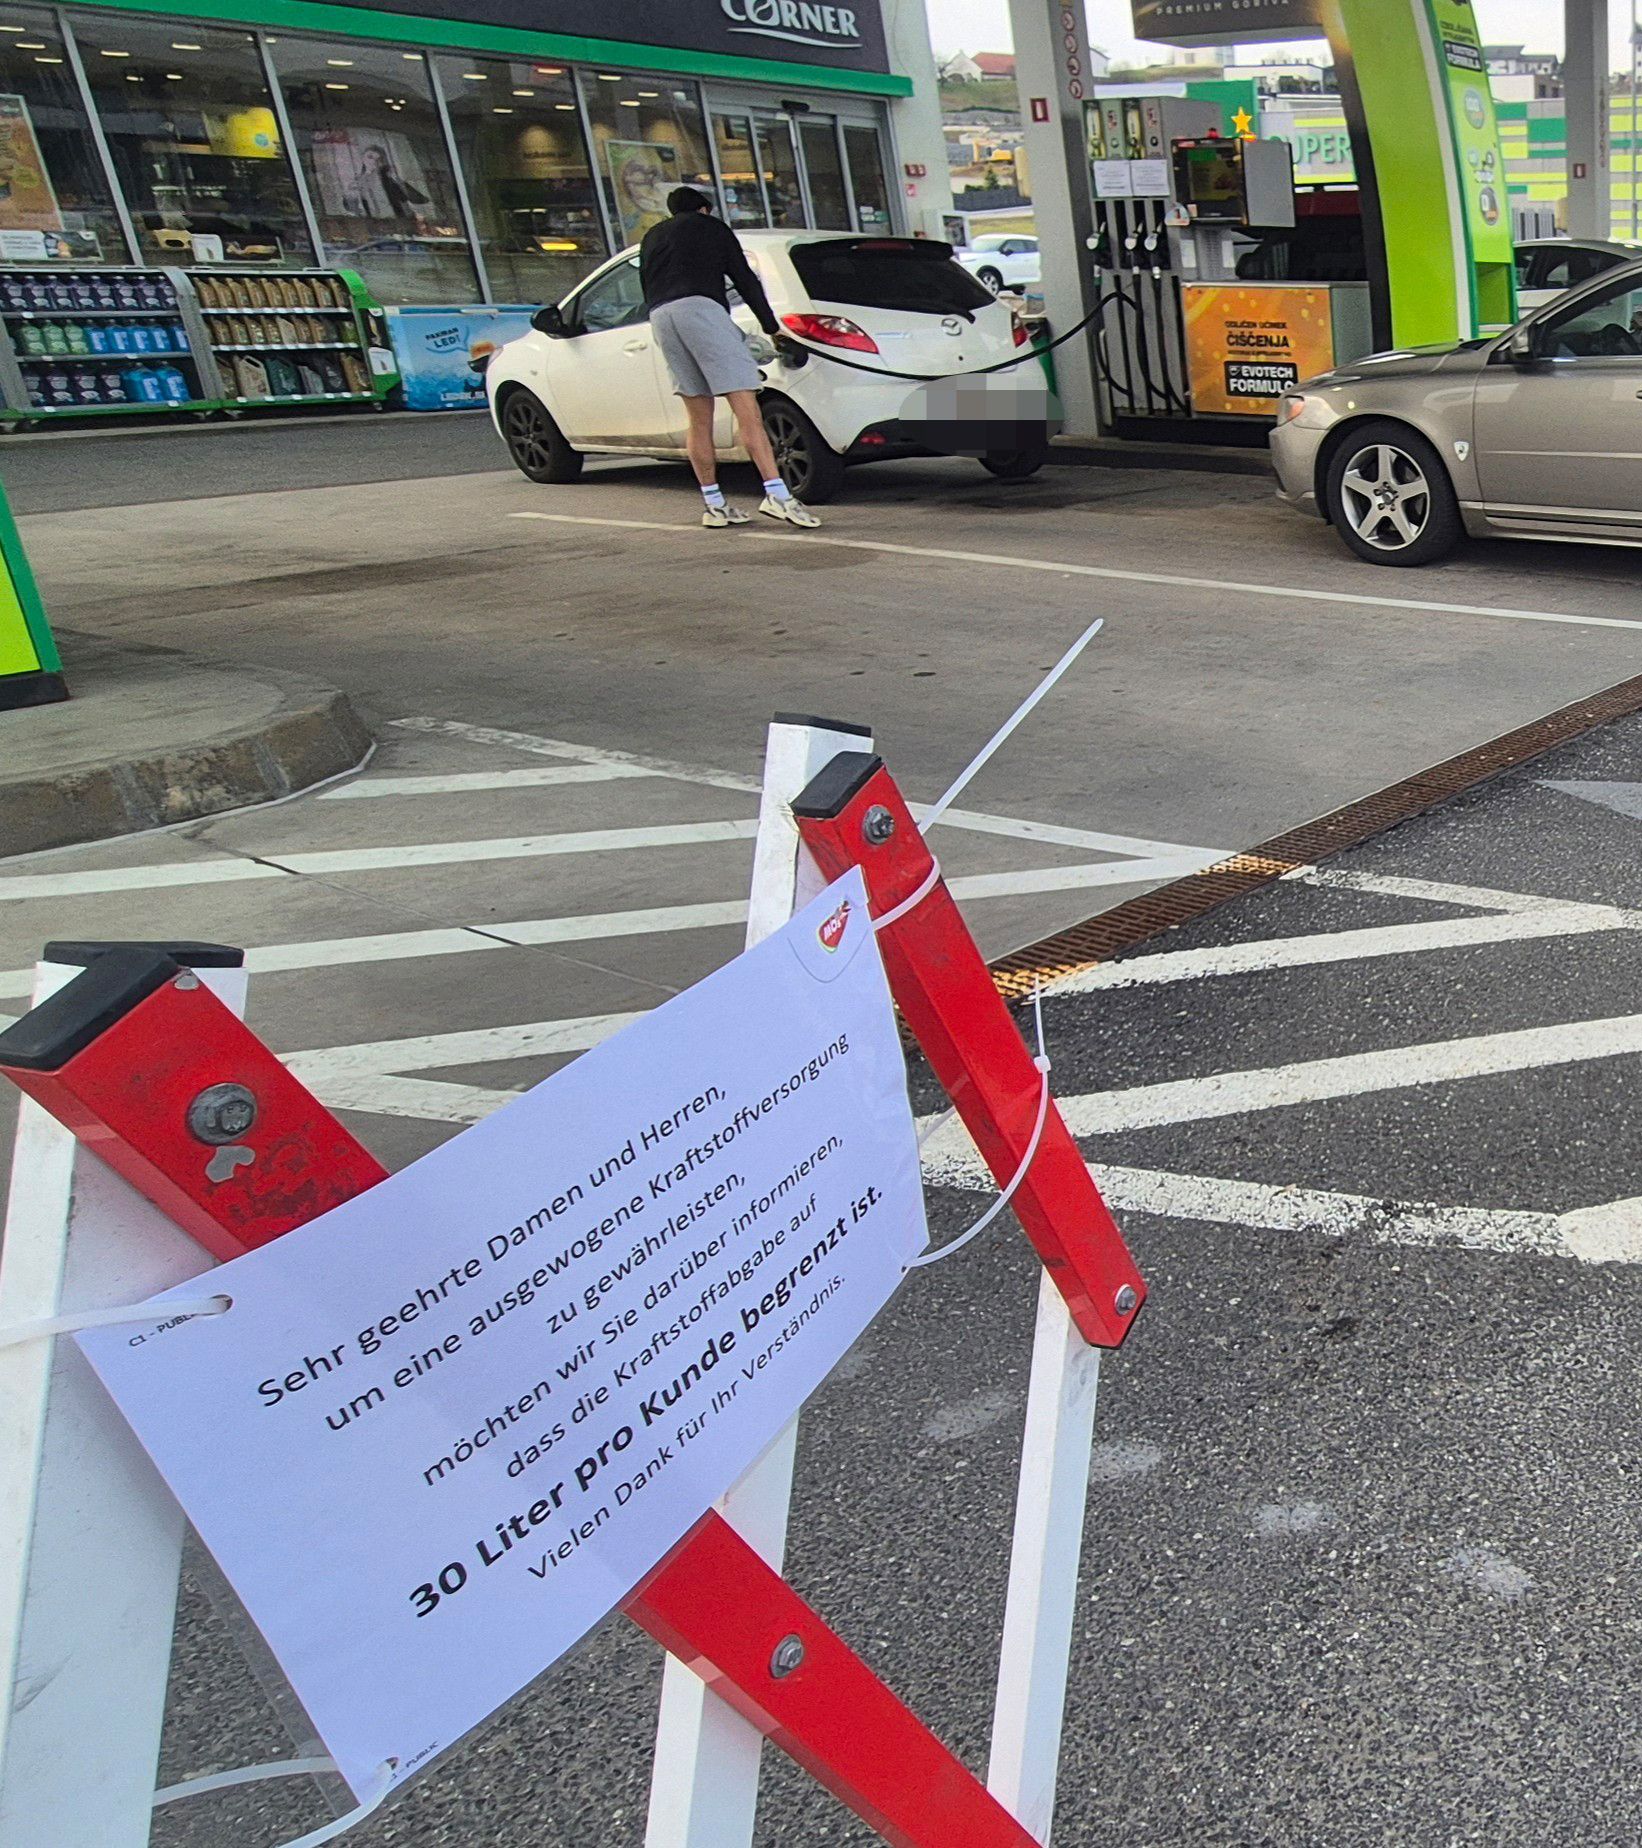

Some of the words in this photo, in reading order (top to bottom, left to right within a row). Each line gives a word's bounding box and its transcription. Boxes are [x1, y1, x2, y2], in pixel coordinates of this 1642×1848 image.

[720, 0, 861, 38] CORNER
[1156, 3, 1222, 16] PREMIUM
[1268, 133, 1351, 164] UPER
[1226, 331, 1290, 348] ČIŠČENJA
[1241, 366, 1293, 378] EVOTECH
[258, 1345, 345, 1407] Sehr
[358, 1259, 483, 1356] geehrte
[487, 1186, 584, 1262] Damen
[590, 1140, 637, 1188] und
[641, 1087, 727, 1151] Herren,
[326, 1388, 386, 1431] um
[394, 1335, 463, 1388] eine
[469, 1196, 645, 1336] ausgewogene
[649, 1034, 849, 1200] Kraftstoffversorgung
[424, 1382, 552, 1486] möchten
[556, 1340, 596, 1380] wir
[602, 1310, 639, 1345] Sie
[644, 1231, 727, 1310] darüber
[733, 1137, 843, 1236] informieren,
[547, 1302, 578, 1335] zu
[584, 1174, 746, 1307] gewährleisten,
[155, 1313, 197, 1334] PUBL
[409, 1562, 468, 1618] 30
[476, 1482, 564, 1567] Liter
[575, 1426, 634, 1493] pro
[640, 1332, 737, 1427] Kunde
[741, 1218, 848, 1334] begrenzt
[851, 1187, 883, 1224] ist.
[508, 1423, 566, 1478] dass
[572, 1387, 610, 1424] die
[614, 1230, 786, 1388] Kraftstoffabgabe
[790, 1193, 816, 1233] auf
[528, 1507, 610, 1579] Vielen
[615, 1447, 674, 1507] Dank
[677, 1412, 707, 1448] für
[712, 1381, 739, 1417] Ihr
[742, 1275, 846, 1381] Verständnis.
